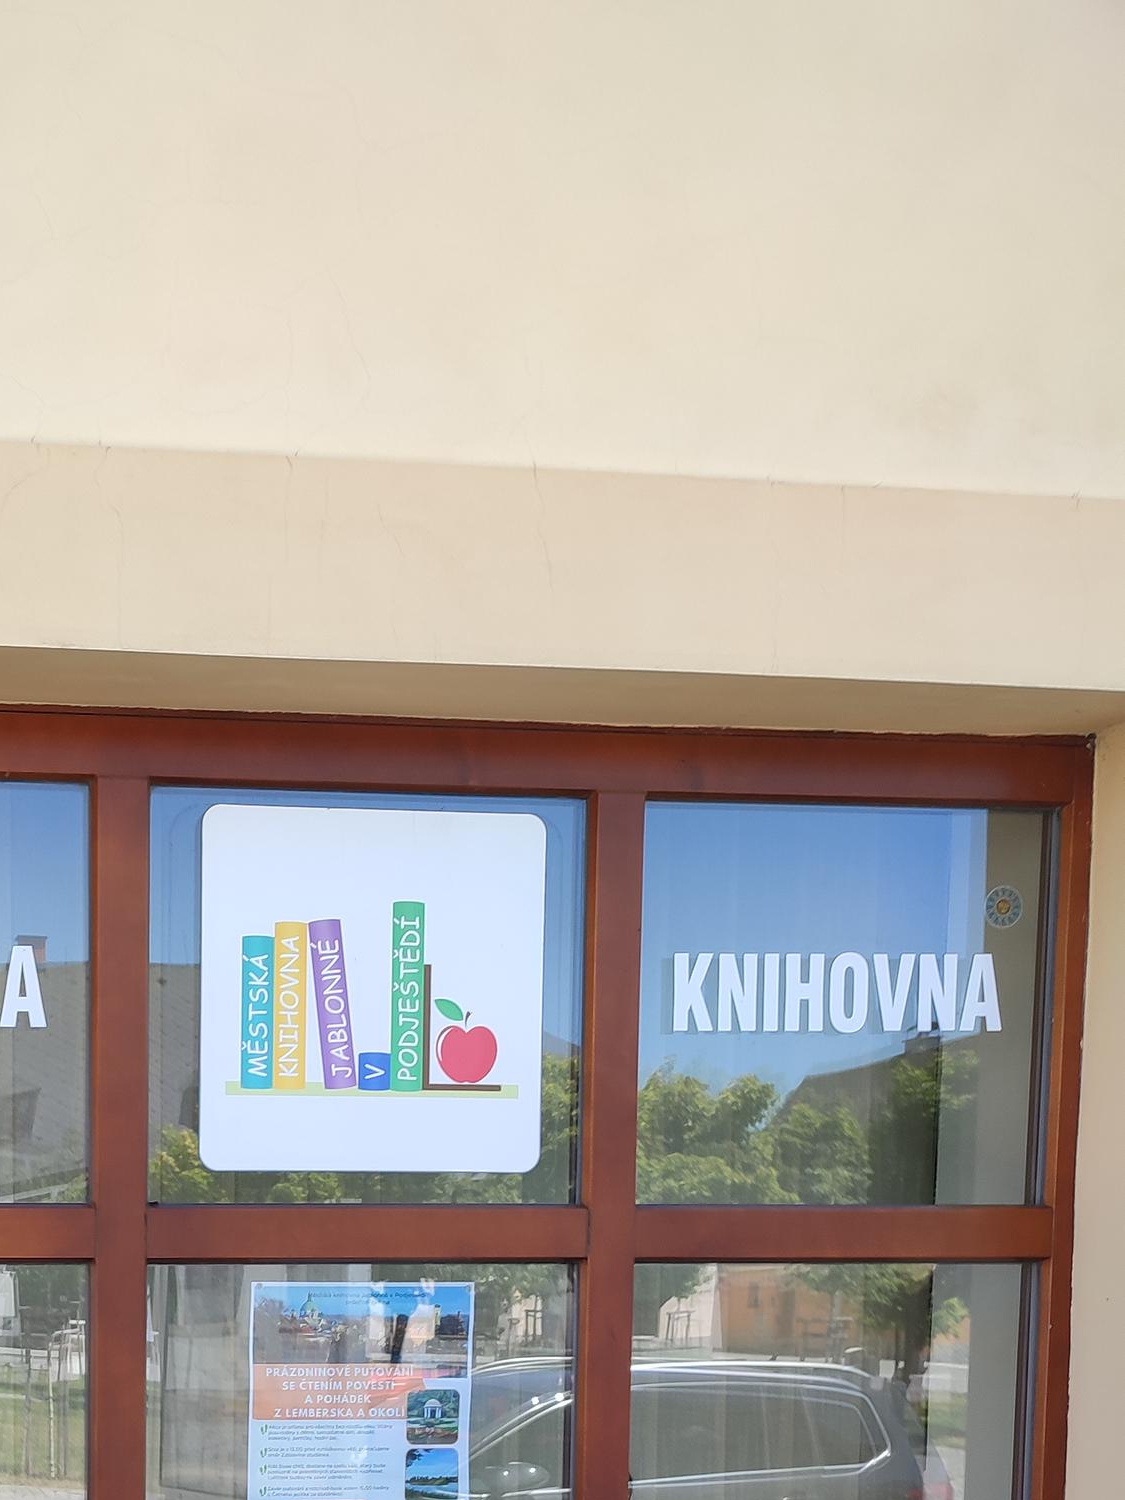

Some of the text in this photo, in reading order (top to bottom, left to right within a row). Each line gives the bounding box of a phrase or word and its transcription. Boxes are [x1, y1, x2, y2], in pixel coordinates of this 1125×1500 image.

[241, 916, 420, 1081] MĚSTSKÁ KNIHOVNA JABLONNÉ V PODJEŠTĚDÍ
[672, 952, 1003, 1033] KNIHOVNA
[266, 1365, 350, 1377] PRÁZDNINOVÉ
[282, 1381, 297, 1390] SE
[299, 1378, 342, 1390] ČTENÍM
[305, 1393, 371, 1404] A POHÁDEK
[274, 1409, 281, 1417] Z
[285, 1408, 354, 1417] LEMBERSKA
[357, 1408, 365, 1417] A
